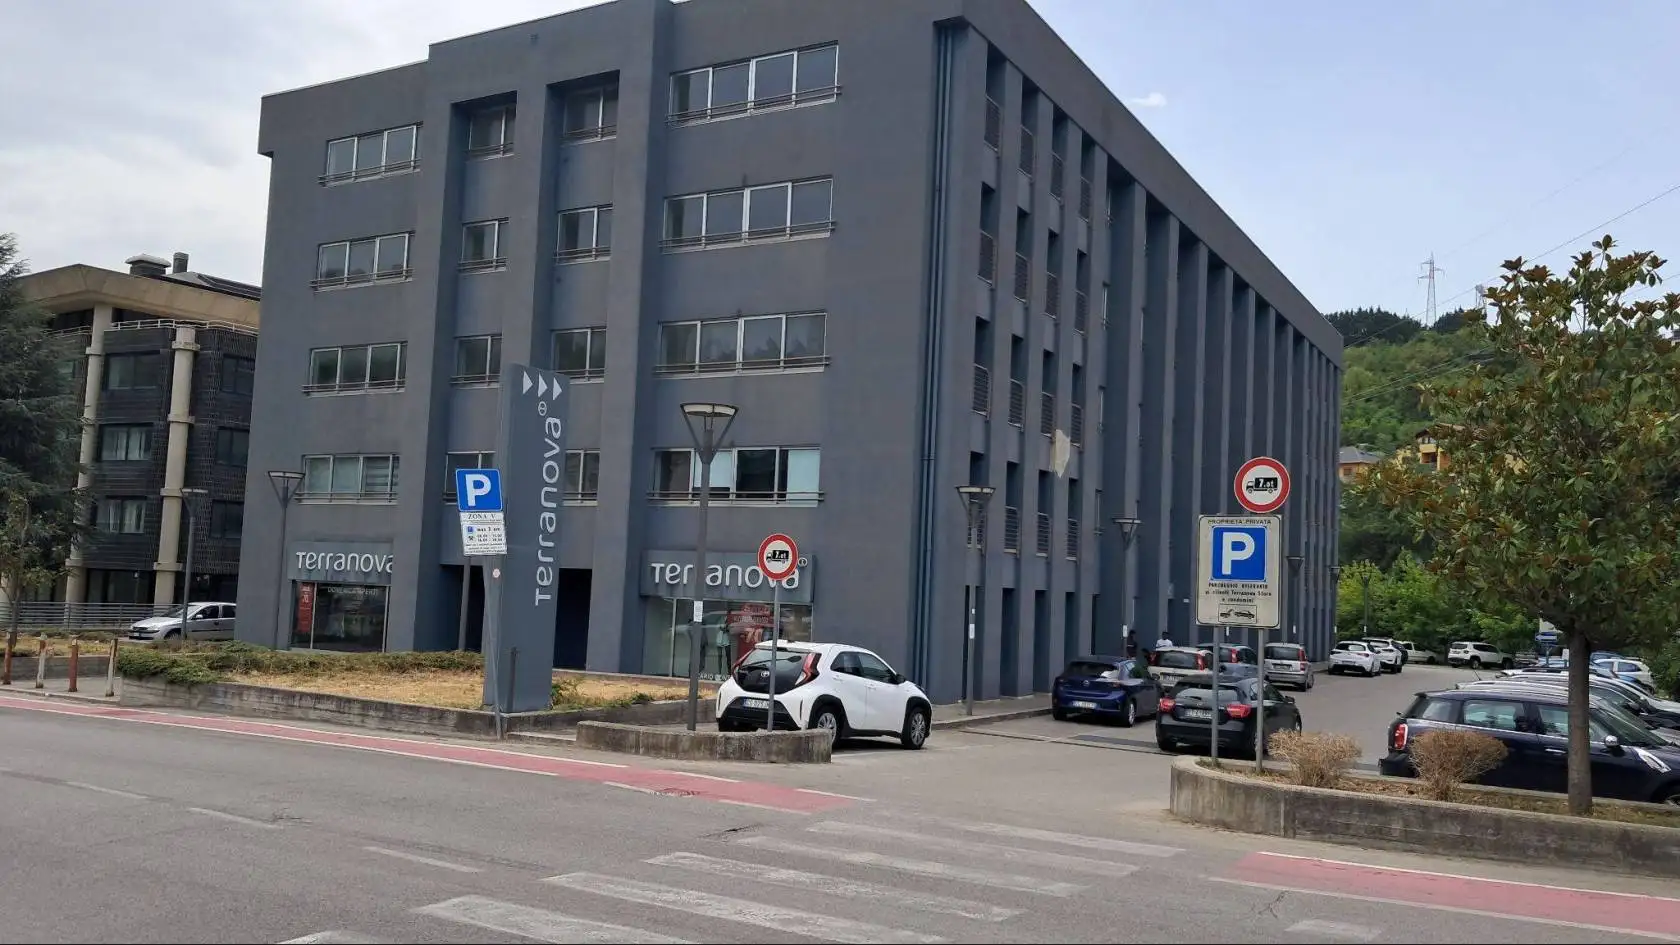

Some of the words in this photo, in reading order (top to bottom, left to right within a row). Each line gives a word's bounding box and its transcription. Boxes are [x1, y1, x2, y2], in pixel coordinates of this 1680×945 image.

[465, 474, 492, 506] P
[296, 551, 393, 573] Terranova
[1222, 532, 1255, 575] P
